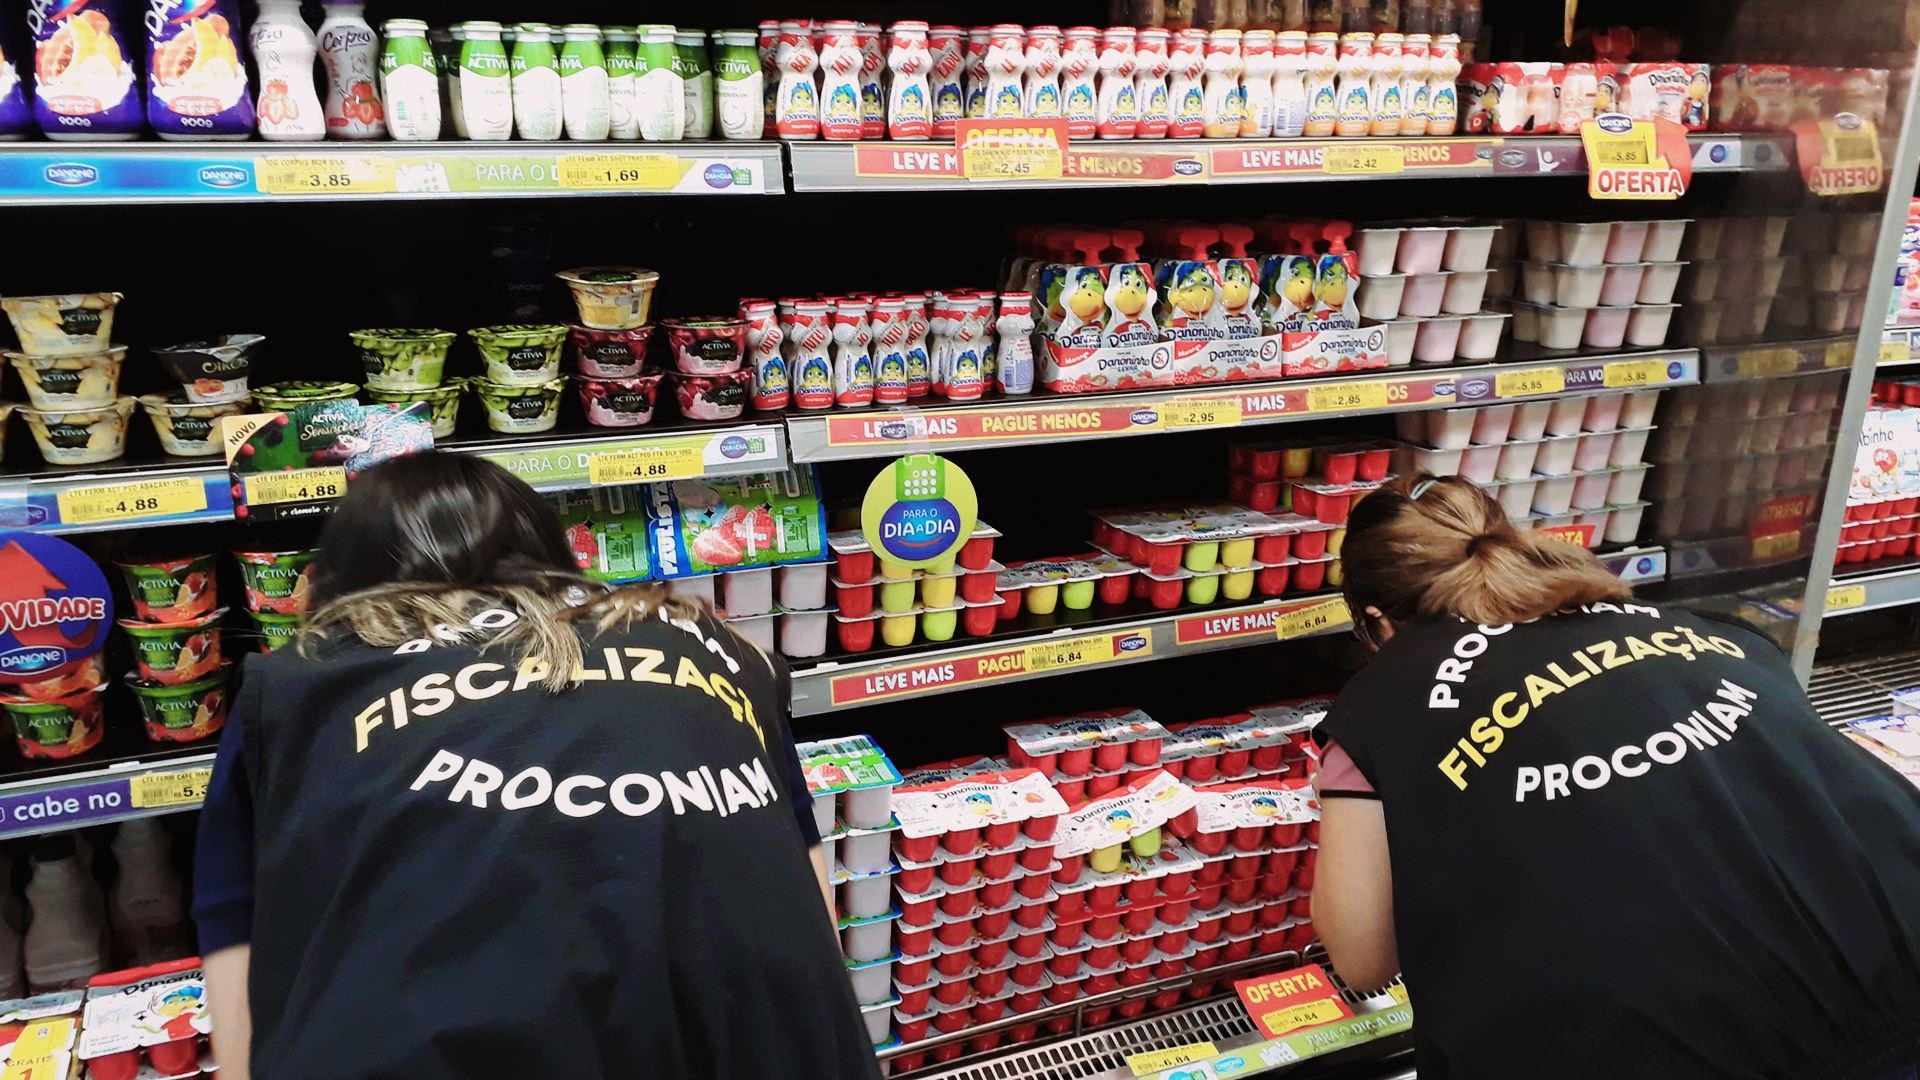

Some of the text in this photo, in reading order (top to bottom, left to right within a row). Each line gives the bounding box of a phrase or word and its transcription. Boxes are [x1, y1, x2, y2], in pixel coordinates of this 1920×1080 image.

[467, 56, 510, 70] ACTIVI
[893, 151, 945, 171] LEVE
[1242, 149, 1323, 168] LEVE MAIS
[1353, 159, 1378, 169] 2.42
[1001, 162, 1030, 175] 2.45
[1080, 156, 1143, 175] MENOS
[48, 169, 95, 180] DANONE
[201, 169, 245, 182] DANONE
[475, 164, 545, 182] PARA O
[605, 170, 639, 182] 1.69
[310, 174, 351, 187] 3.85
[1599, 170, 1683, 193] OFERTA
[1163, 326, 1224, 341] Danoninho
[1320, 338, 1367, 353] Danoninho
[511, 352, 544, 360] ACTIVIA
[1209, 347, 1259, 362] Danoninho
[1099, 355, 1150, 371] Danoninho
[1564, 370, 1588, 384] ARA
[614, 394, 643, 402] ACTIVIA
[1246, 394, 1286, 412] MAIS
[1337, 395, 1361, 406] 2.95
[511, 401, 543, 409] ACTIVIA
[312, 412, 347, 424] ACTIVIA
[981, 414, 1037, 433] PAGUE
[1042, 412, 1101, 431] MENOS
[1189, 412, 1215, 423] 2.95
[174, 422, 209, 430] ACTIVIA
[228, 420, 257, 446] NOVO
[506, 455, 573, 474] PARA O
[633, 464, 667, 477] 4.88
[298, 485, 337, 498] 4.88
[116, 498, 159, 513] 4.88
[903, 508, 938, 520] PARA O
[256, 569, 298, 579] ACTIVIA
[138, 578, 181, 589] ACTIVIA
[1204, 611, 1280, 635] LEVE MAIS
[1304, 615, 1327, 629] 6.84
[139, 641, 182, 651] ACTIVIA
[1120, 638, 1146, 649] DANONE
[1, 650, 61, 668] DANONE
[1056, 652, 1082, 664] 6.84
[865, 653, 1026, 694] LEVE MAIS PAGU
[155, 699, 199, 711] ACTIVIA
[1437, 625, 1746, 791] FISCALIZAÇÃO
[29, 715, 74, 728] ACTIVIA
[183, 786, 208, 798] 5.3
[935, 783, 999, 800] Danoninho
[1224, 789, 1283, 801] Danoninho
[14, 791, 121, 821] cabe no
[1072, 796, 1136, 823] Danoninho
[1246, 972, 1323, 1004] OFERTA
